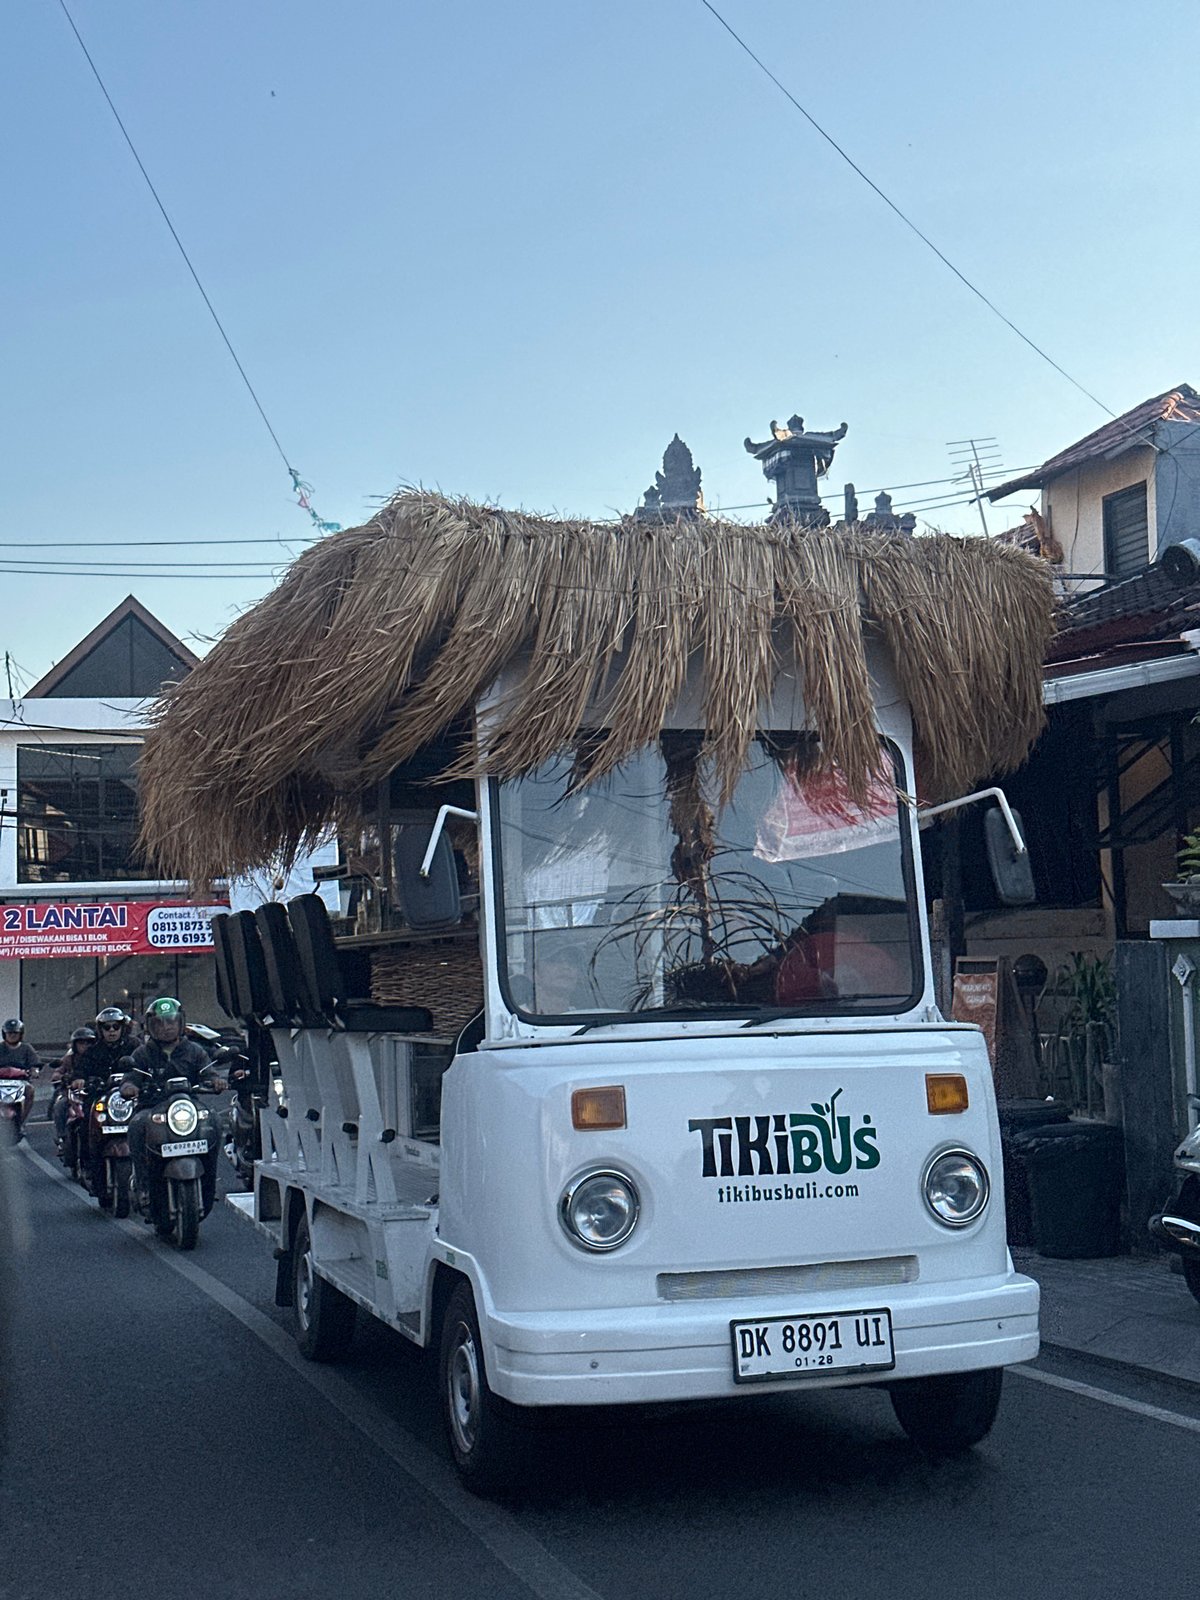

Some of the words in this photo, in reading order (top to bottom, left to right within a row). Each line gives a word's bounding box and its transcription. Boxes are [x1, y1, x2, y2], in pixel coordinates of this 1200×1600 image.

[3, 908, 22, 931] 2
[26, 905, 127, 930] LANTAI
[158, 911, 191, 919] Contact
[152, 922, 177, 932] 0813
[179, 921, 203, 931] 1873
[20, 934, 65, 943] DISEWAKAN
[66, 934, 83, 942] BISA
[89, 933, 108, 942] BLOK
[152, 934, 179, 944] 0878
[182, 933, 206, 943] 6193
[15, 947, 30, 955] FOR
[31, 946, 51, 955] RENT
[51, 945, 91, 954] AVAILABLE
[92, 944, 107, 953] PER
[108, 943, 132, 952] BLOCK
[718, 1181, 859, 1203] tikibusbali.com
[739, 1326, 771, 1358] DK
[782, 1320, 842, 1353] 8891
[855, 1317, 885, 1347] UI
